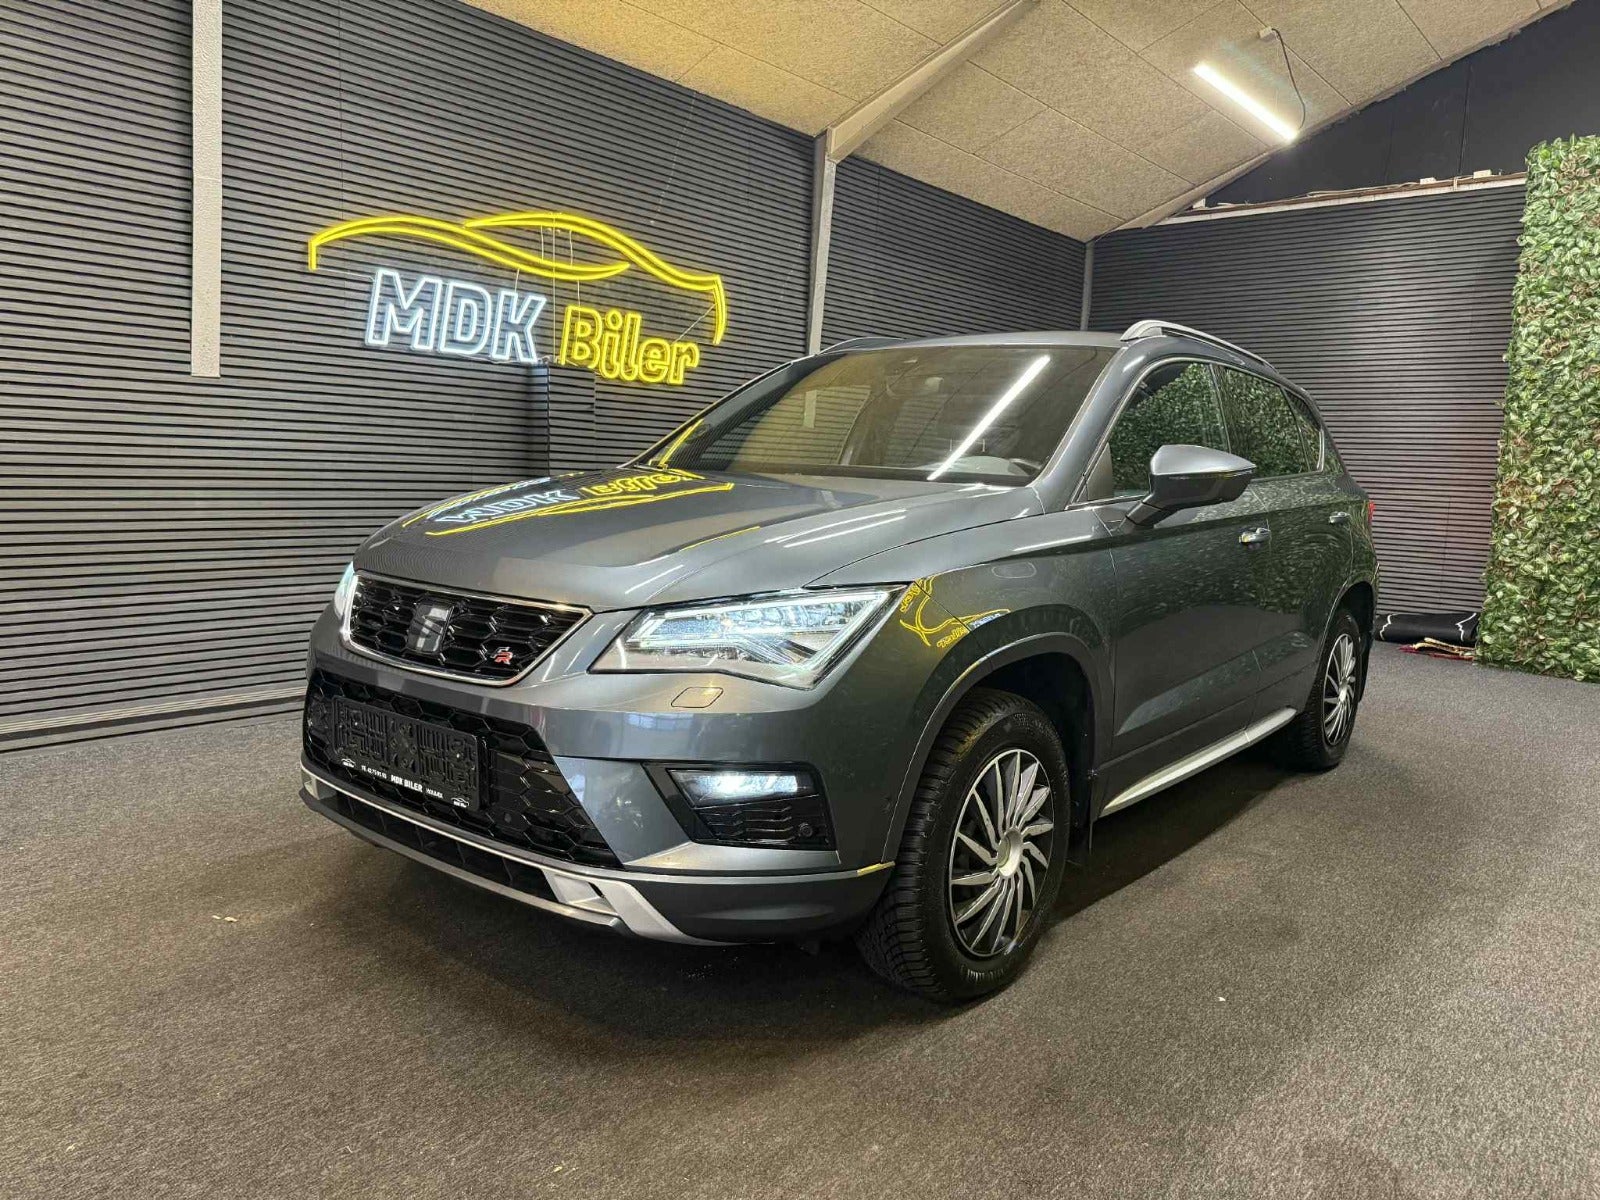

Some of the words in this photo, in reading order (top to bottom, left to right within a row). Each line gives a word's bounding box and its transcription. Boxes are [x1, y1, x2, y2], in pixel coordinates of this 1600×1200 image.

[366, 269, 546, 363] MDK
[559, 304, 701, 386] Biler
[403, 779, 423, 793] BILER
